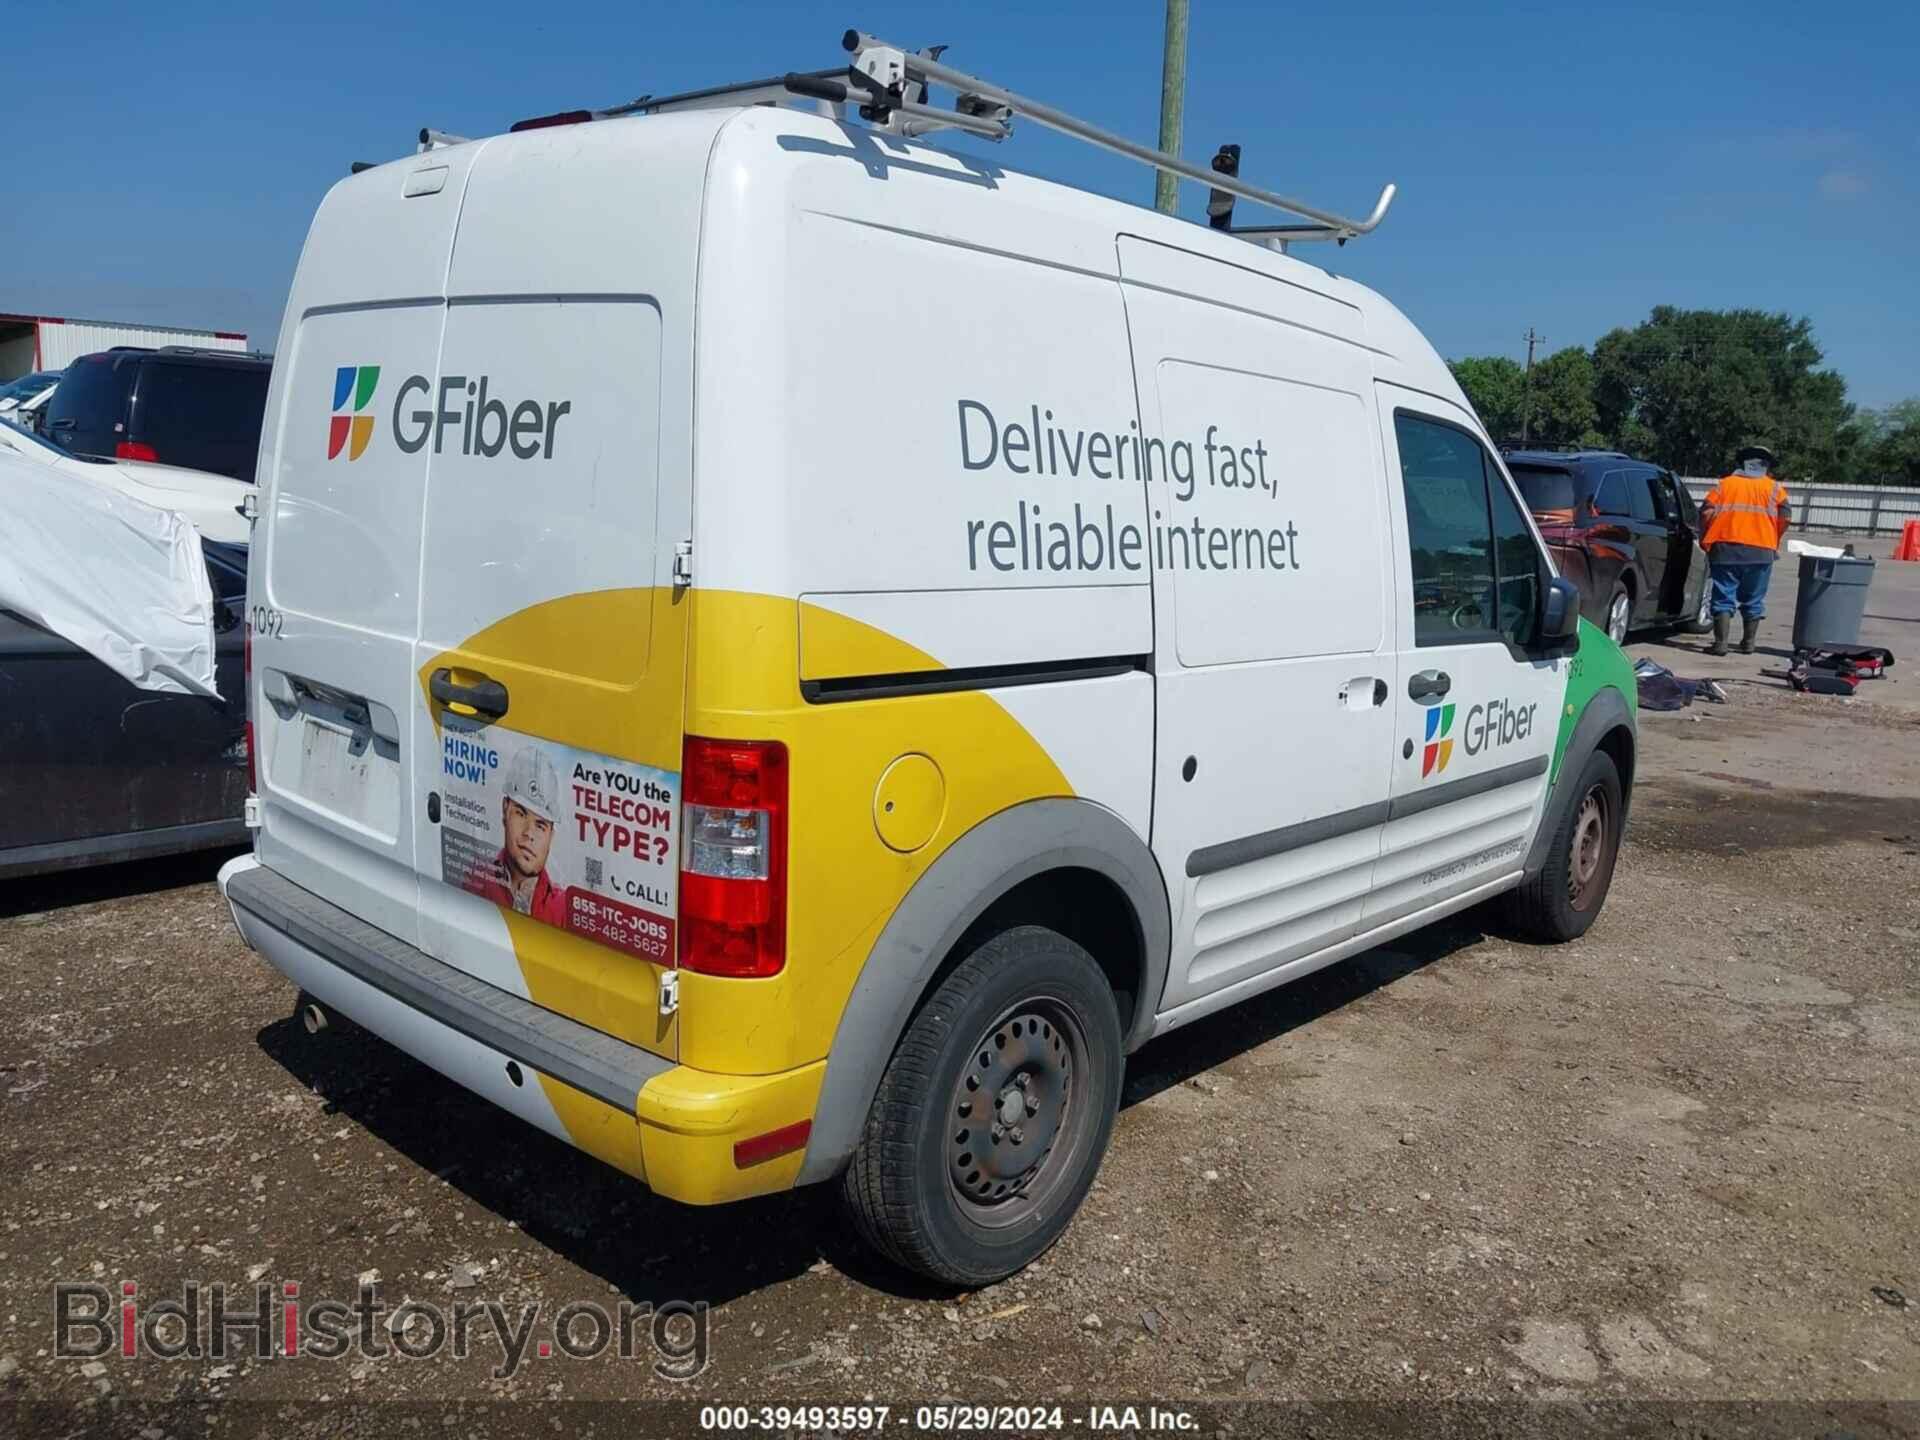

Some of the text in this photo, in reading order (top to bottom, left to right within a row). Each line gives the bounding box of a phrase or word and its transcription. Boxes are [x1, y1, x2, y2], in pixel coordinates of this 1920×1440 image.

[392, 375, 571, 460] GFiber
[958, 399, 1278, 502] Delivering fast,
[967, 500, 1300, 571] reliable internet
[253, 605, 283, 640] 1092
[1464, 697, 1537, 756] GFiber
[444, 756, 486, 786] NOW!
[445, 735, 498, 769] HIRING
[573, 763, 671, 804] Are YOU the
[572, 784, 671, 832] TELECOM
[575, 812, 669, 865] TYPE?
[626, 880, 668, 907] CALL!
[572, 896, 668, 940] 855-ITC-JOBS
[572, 912, 668, 957] 855-482-5627
